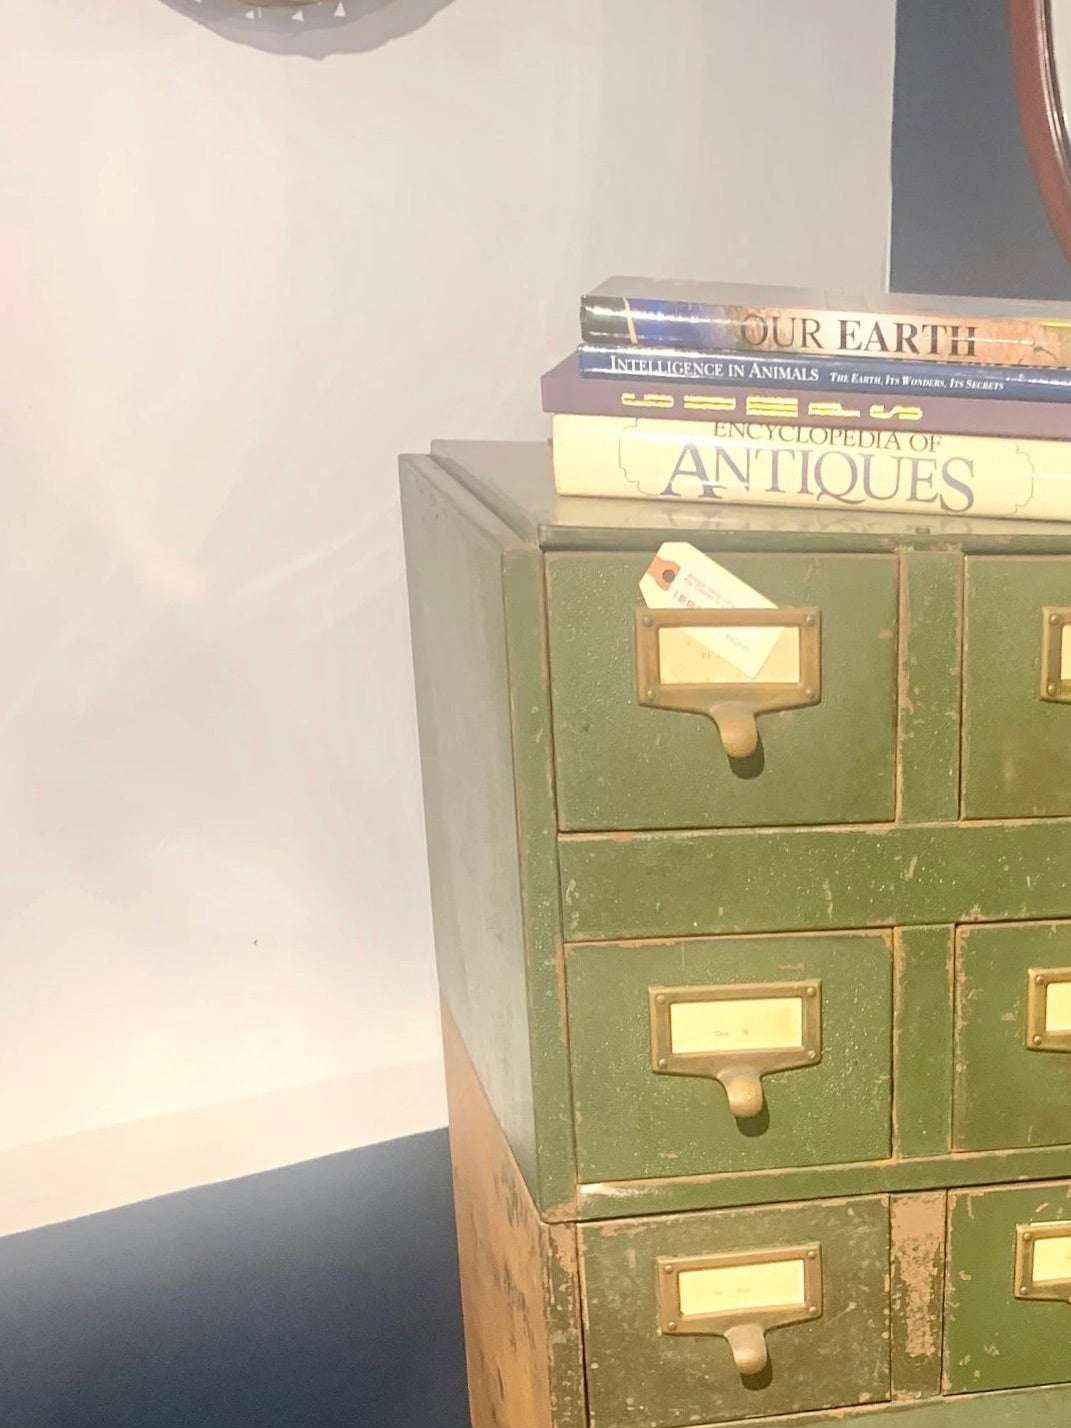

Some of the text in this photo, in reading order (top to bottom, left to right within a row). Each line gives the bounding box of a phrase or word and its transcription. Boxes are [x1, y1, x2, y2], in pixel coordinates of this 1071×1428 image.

[741, 314, 977, 357] OUR EARTH
[610, 355, 819, 381] INTELLIGENCE IN ANIMALS
[830, 372, 849, 383] THE
[885, 375, 900, 386] ITS
[949, 378, 964, 389] ITS
[965, 379, 1004, 391] SECRETS
[713, 421, 943, 452] ENCYCLOPEDIA OF
[659, 443, 975, 512] ANTIQUES
